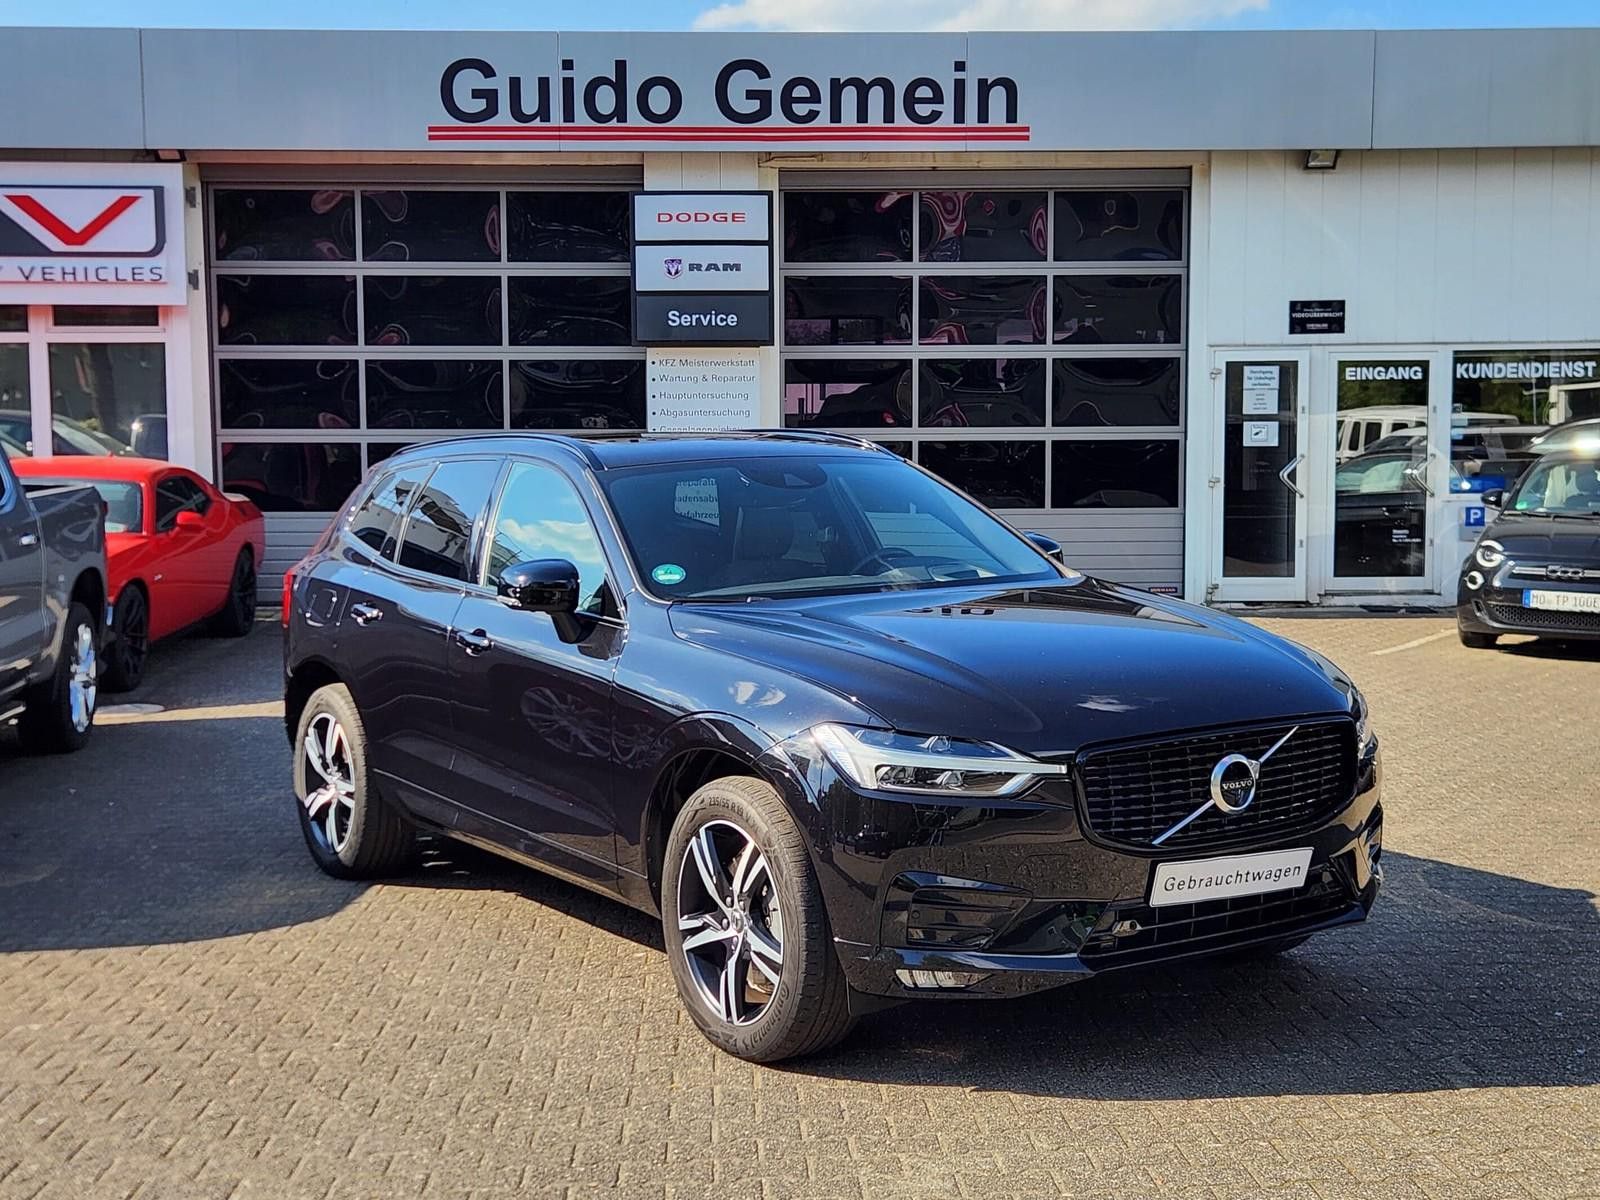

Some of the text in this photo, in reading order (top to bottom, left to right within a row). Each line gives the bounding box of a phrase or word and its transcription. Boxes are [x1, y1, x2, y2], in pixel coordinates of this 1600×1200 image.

[440, 58, 1019, 124] Guido Gemein
[657, 212, 746, 223] DODGE
[18, 266, 163, 282] VEHICLES
[688, 263, 742, 272] RAM
[667, 310, 738, 327] Service
[658, 358, 755, 367] KFZ Meisterwerkstatt
[1456, 361, 1596, 379] KUNDENDIENST
[659, 374, 756, 384] Wartung & Reparatur
[1345, 365, 1423, 380] EINGANG
[659, 391, 749, 401] Hauptuntersuchung
[659, 408, 751, 418] Abgasuntersuchung
[1470, 509, 1482, 524] P
[1222, 778, 1253, 790] VOLVO
[1164, 864, 1302, 893] Gebrauchtwagen
[750, 980, 790, 1049] Continental
